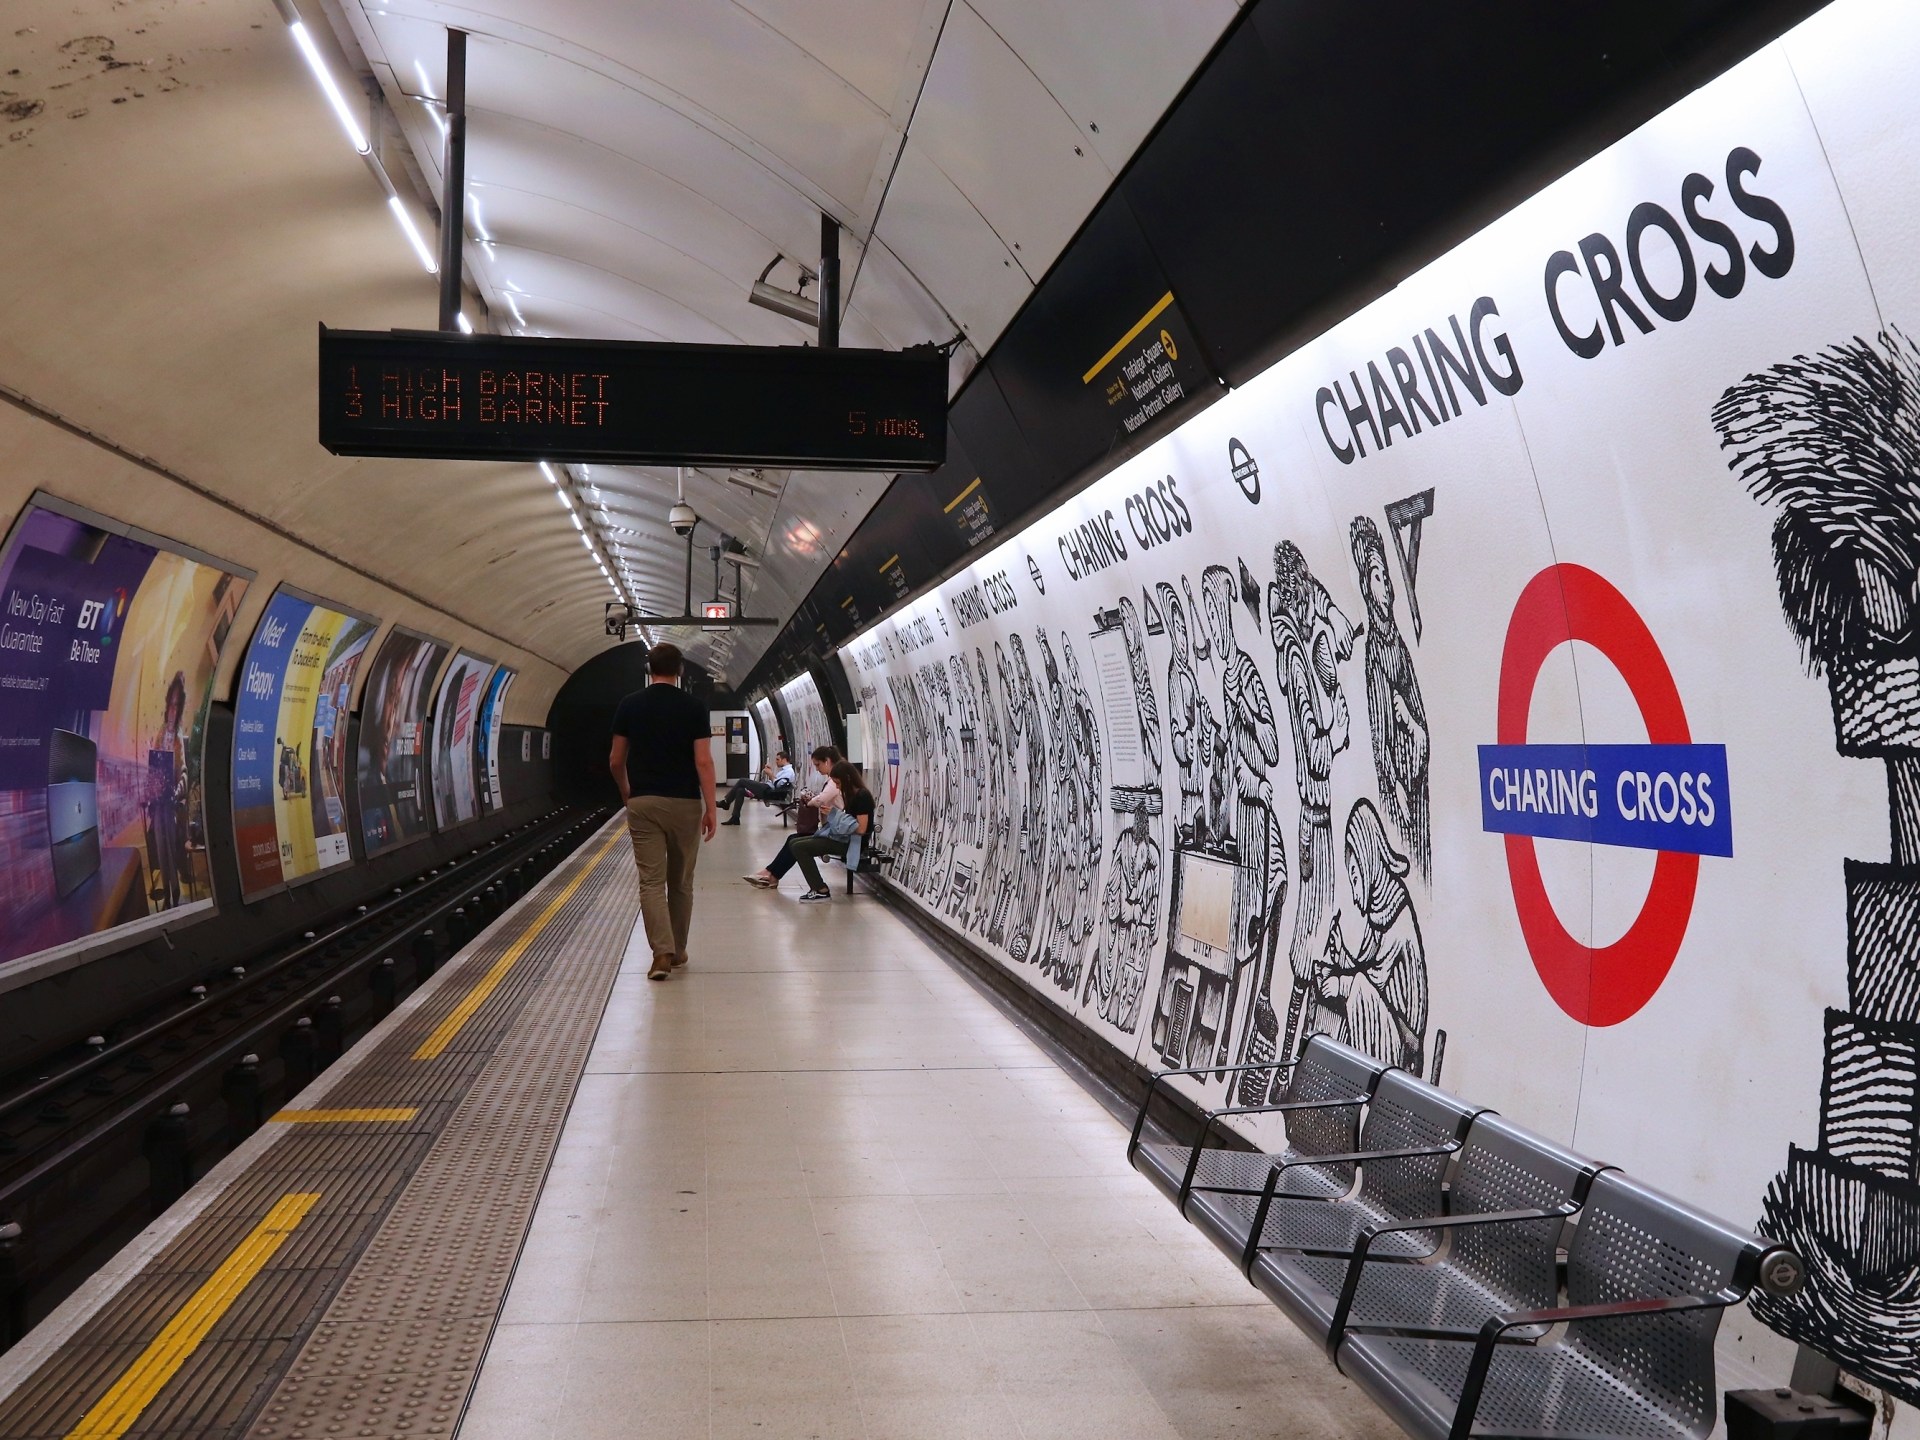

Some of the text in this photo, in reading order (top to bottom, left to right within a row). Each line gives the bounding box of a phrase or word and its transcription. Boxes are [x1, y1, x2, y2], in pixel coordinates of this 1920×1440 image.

[1315, 146, 1795, 465] CHARING CROSS
[1122, 341, 1164, 381] Trafalgar Square
[382, 368, 461, 393] HIGH
[480, 369, 610, 399] BARNET
[1131, 361, 1175, 402] National Gallery
[345, 393, 363, 418] 3
[382, 394, 461, 420] HIGH
[479, 397, 610, 426] BARNET
[848, 410, 866, 435] 5
[1123, 382, 1185, 434] National Portrait Gallery
[1058, 510, 1128, 581] CHARING
[1125, 474, 1192, 551] CROSS
[7, 589, 65, 626] New Stay Fast
[77, 599, 105, 631] BT
[951, 569, 1018, 629] CHARING CROSS
[1, 623, 43, 653] Guarantee
[70, 639, 100, 664] Be There
[259, 615, 288, 648] Meet
[246, 661, 275, 701] Happy.
[238, 747, 248, 761] Clear
[1489, 767, 1715, 827] CHARING CROSS
